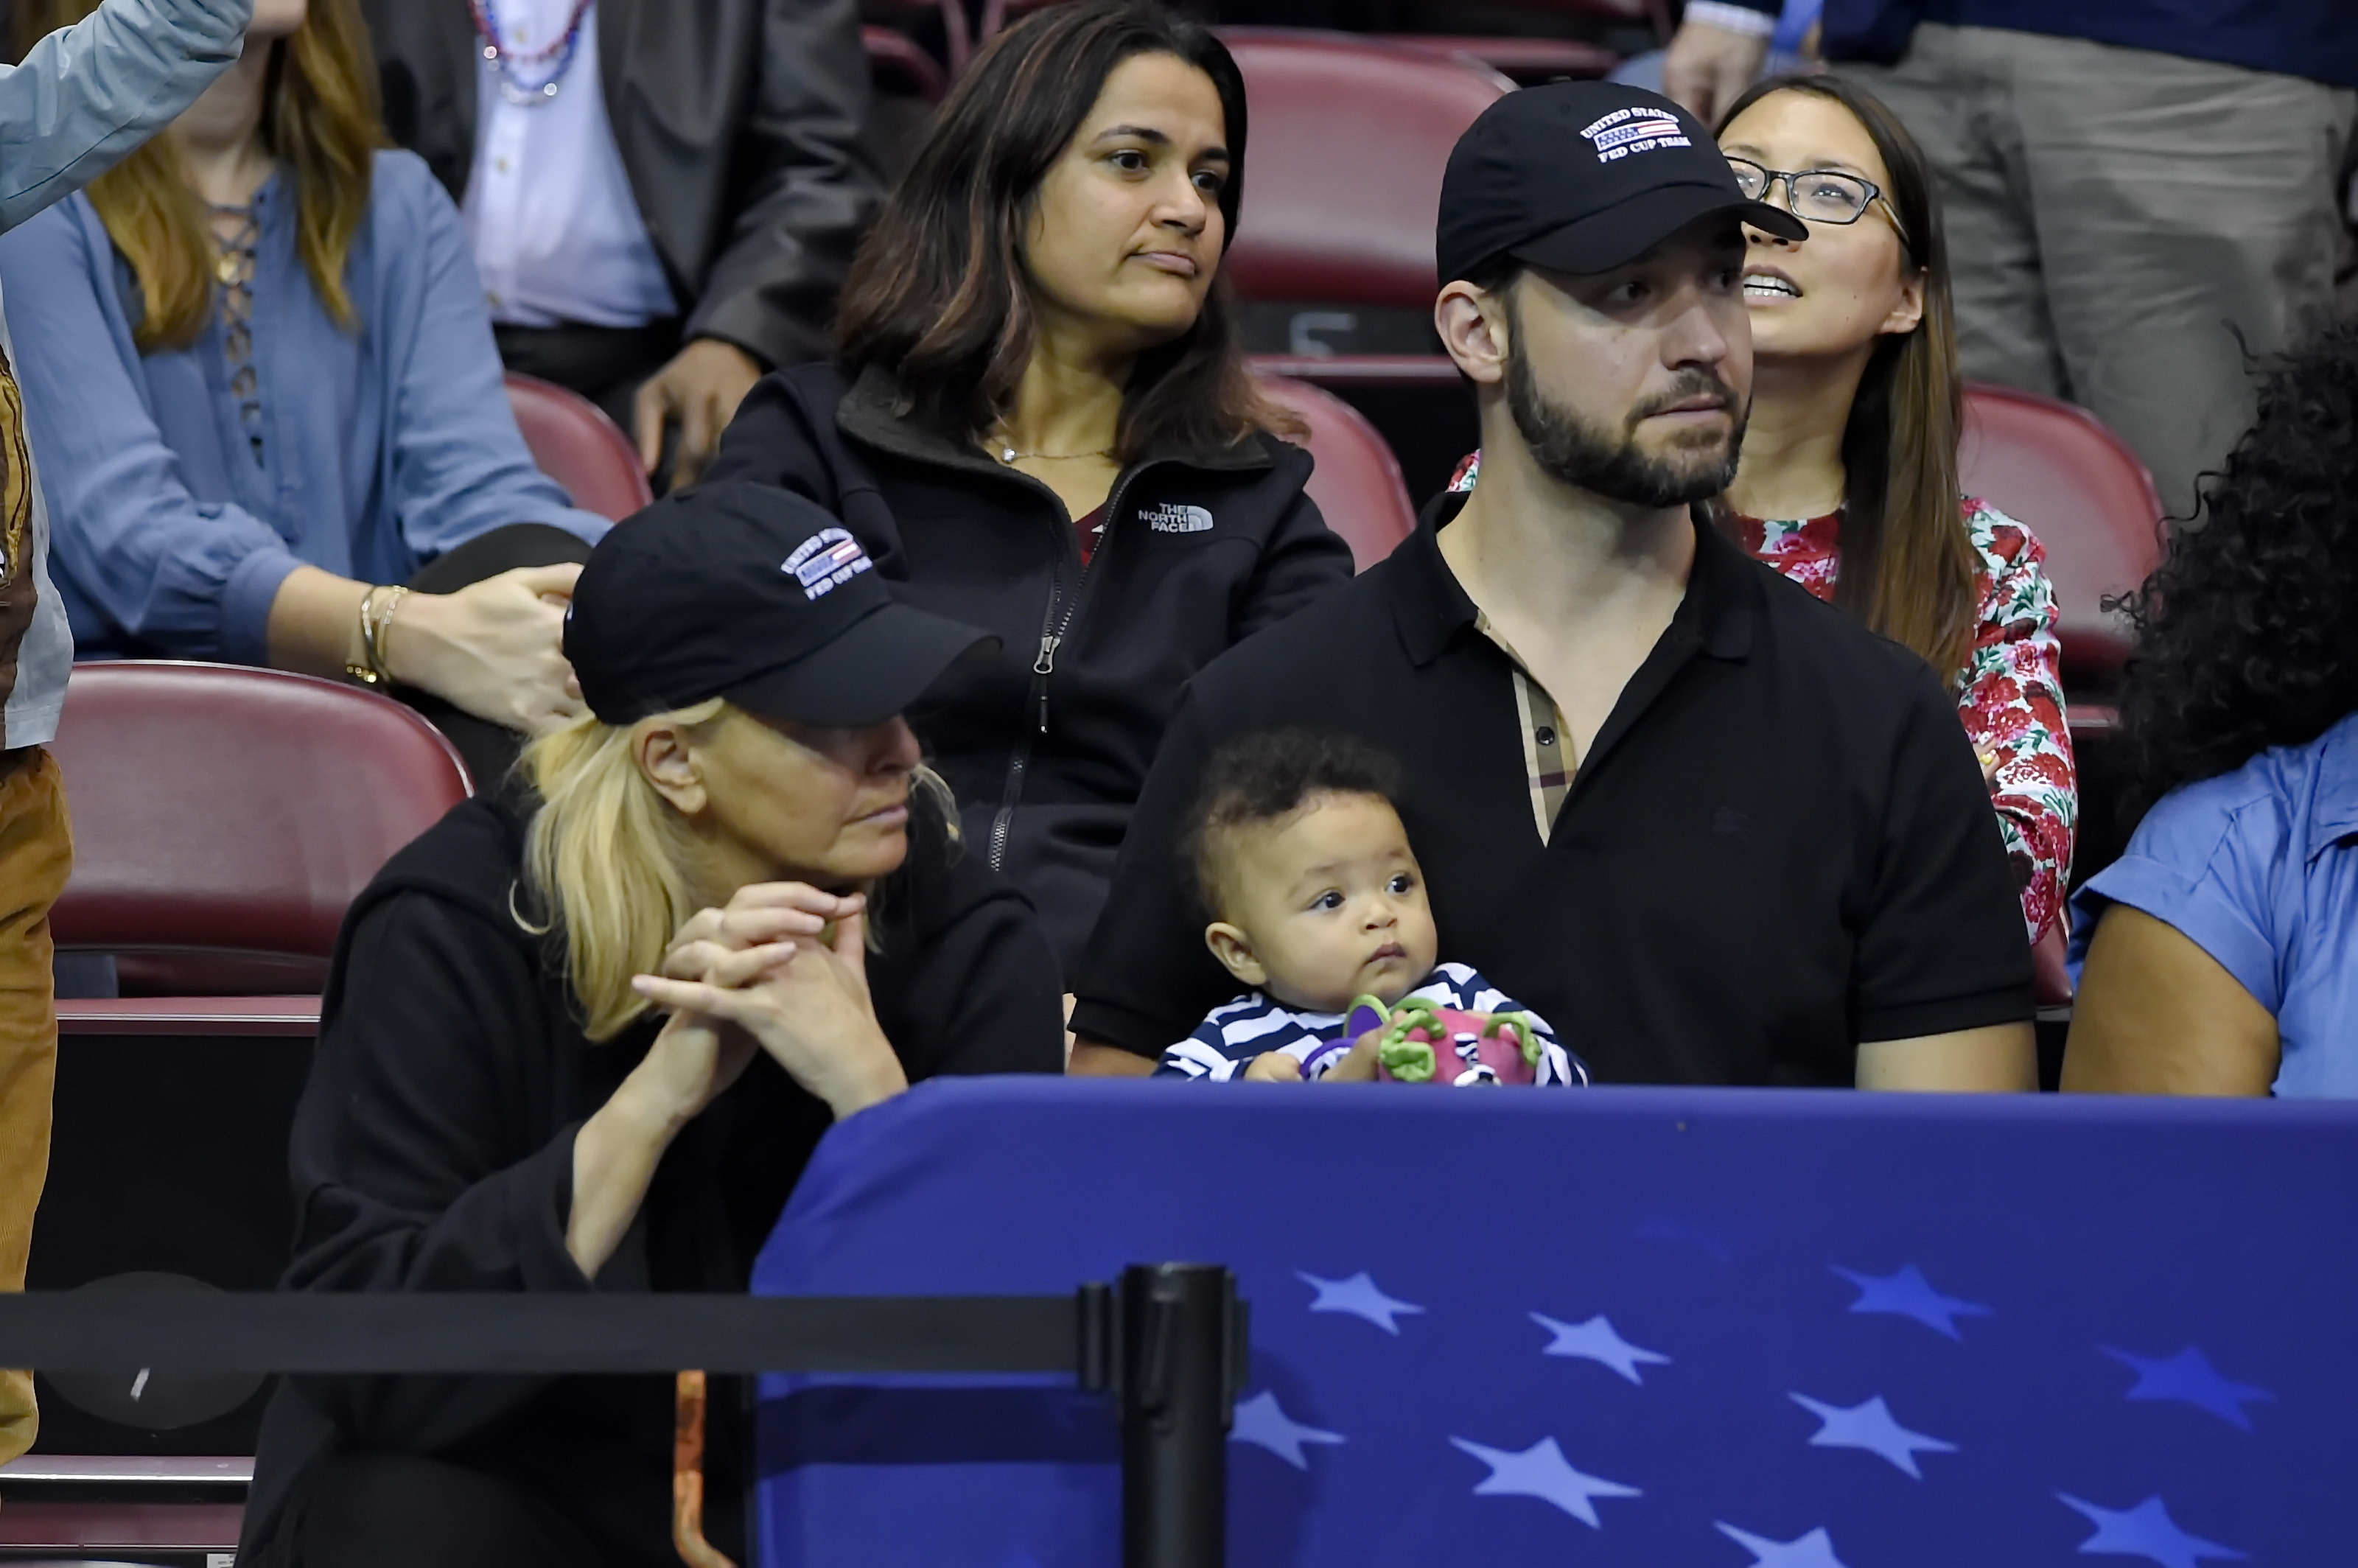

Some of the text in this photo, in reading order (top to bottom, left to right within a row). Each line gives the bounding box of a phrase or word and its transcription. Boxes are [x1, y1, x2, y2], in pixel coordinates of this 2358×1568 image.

[1580, 108, 1631, 139] UNITED
[1598, 146, 1628, 164] FED
[1629, 138, 1656, 153] CUP
[1159, 503, 1187, 515] THE
[1138, 510, 1187, 523] NORTH
[1151, 522, 1188, 532] FACE
